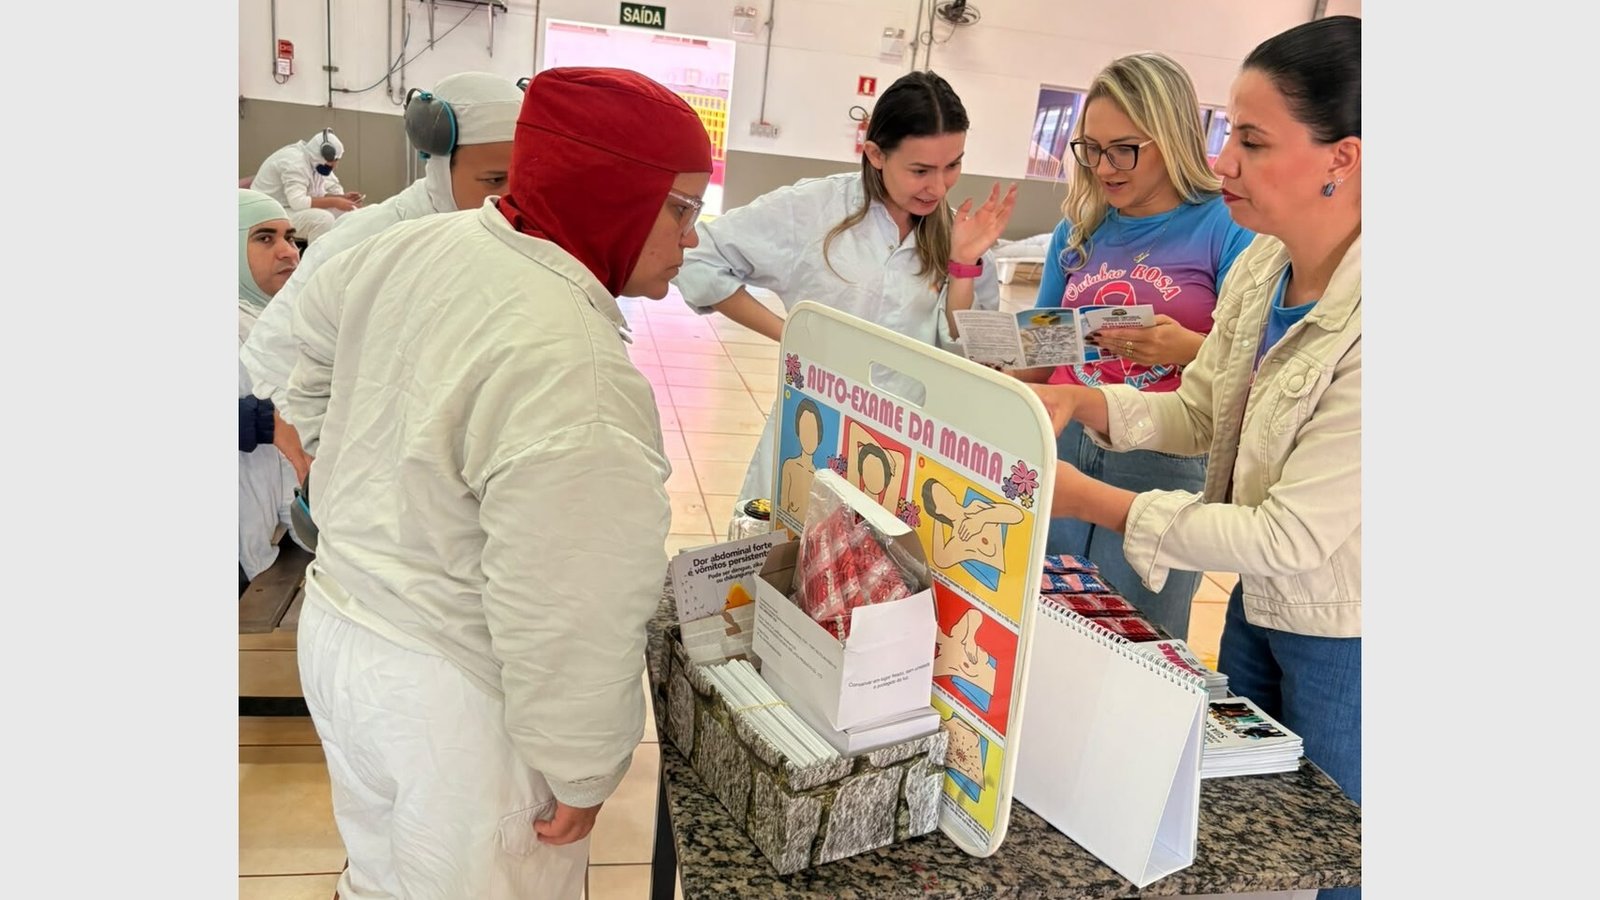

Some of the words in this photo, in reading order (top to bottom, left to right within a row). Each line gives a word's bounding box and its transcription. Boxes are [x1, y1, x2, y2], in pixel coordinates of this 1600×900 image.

[623, 6, 662, 26] SAÍDA
[1130, 263, 1182, 302] ROSA
[807, 364, 904, 433] AUTO-EXAME
[908, 411, 935, 449] DA
[939, 427, 1004, 484] MAMA
[693, 557, 709, 567] Dor
[710, 545, 752, 562] abdominal
[753, 541, 773, 552] forte
[694, 561, 727, 576] vômitos
[728, 550, 770, 568] persistent
